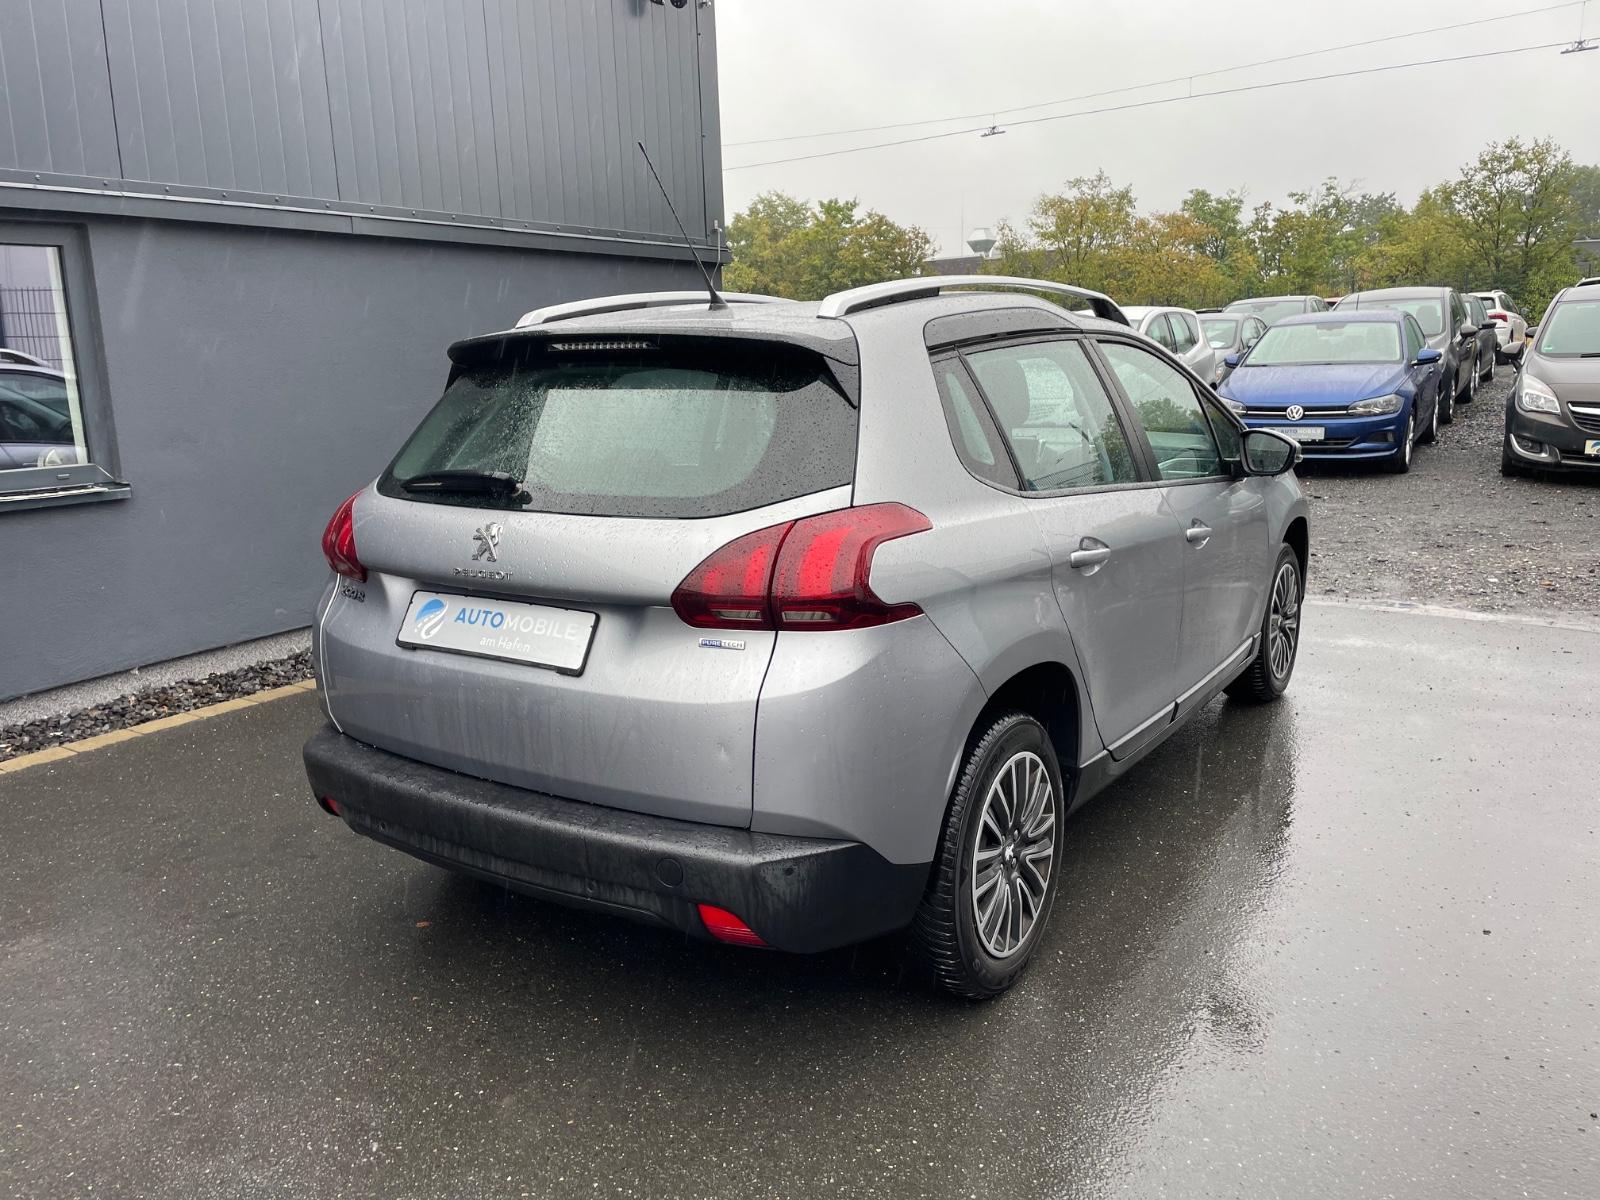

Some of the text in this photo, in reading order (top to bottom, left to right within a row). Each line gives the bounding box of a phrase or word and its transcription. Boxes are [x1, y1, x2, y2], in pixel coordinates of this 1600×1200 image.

[453, 567, 513, 580] PEUGEOT
[454, 607, 580, 641] AUTOMOBILE
[479, 637, 531, 653] am Hafen
